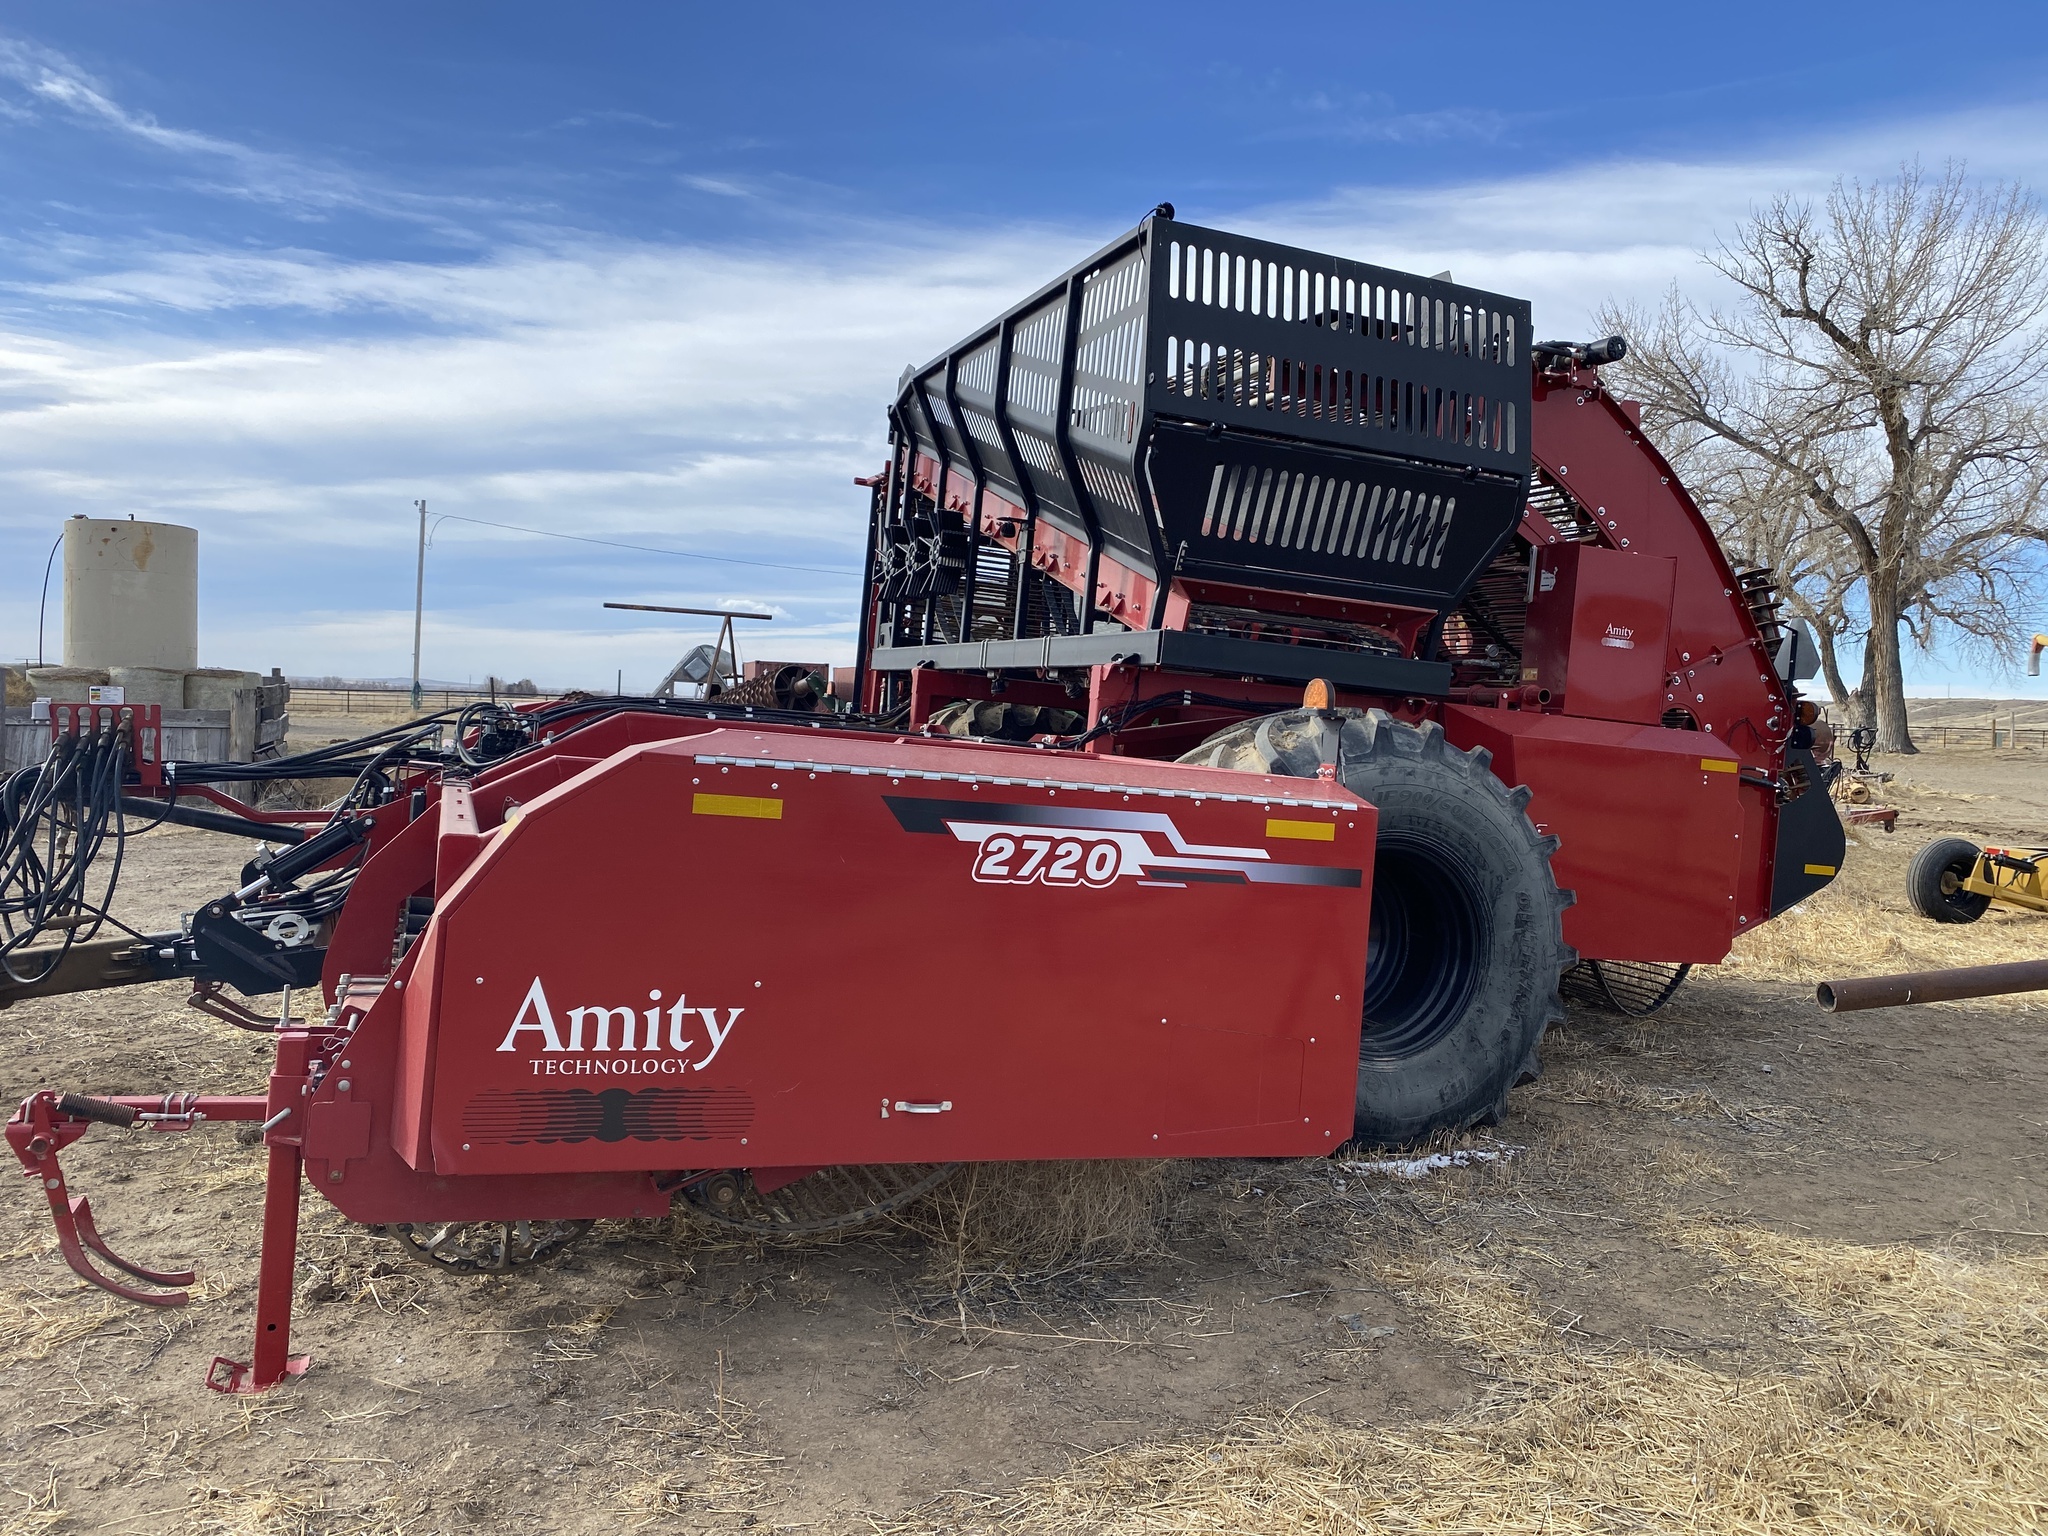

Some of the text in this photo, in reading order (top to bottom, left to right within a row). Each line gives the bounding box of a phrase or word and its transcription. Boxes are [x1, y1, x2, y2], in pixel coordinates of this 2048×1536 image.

[1605, 623, 1634, 639] Amity
[979, 837, 1118, 881] 2720
[496, 976, 745, 1071] Amity
[529, 1058, 690, 1075] TECHNOLOGY
